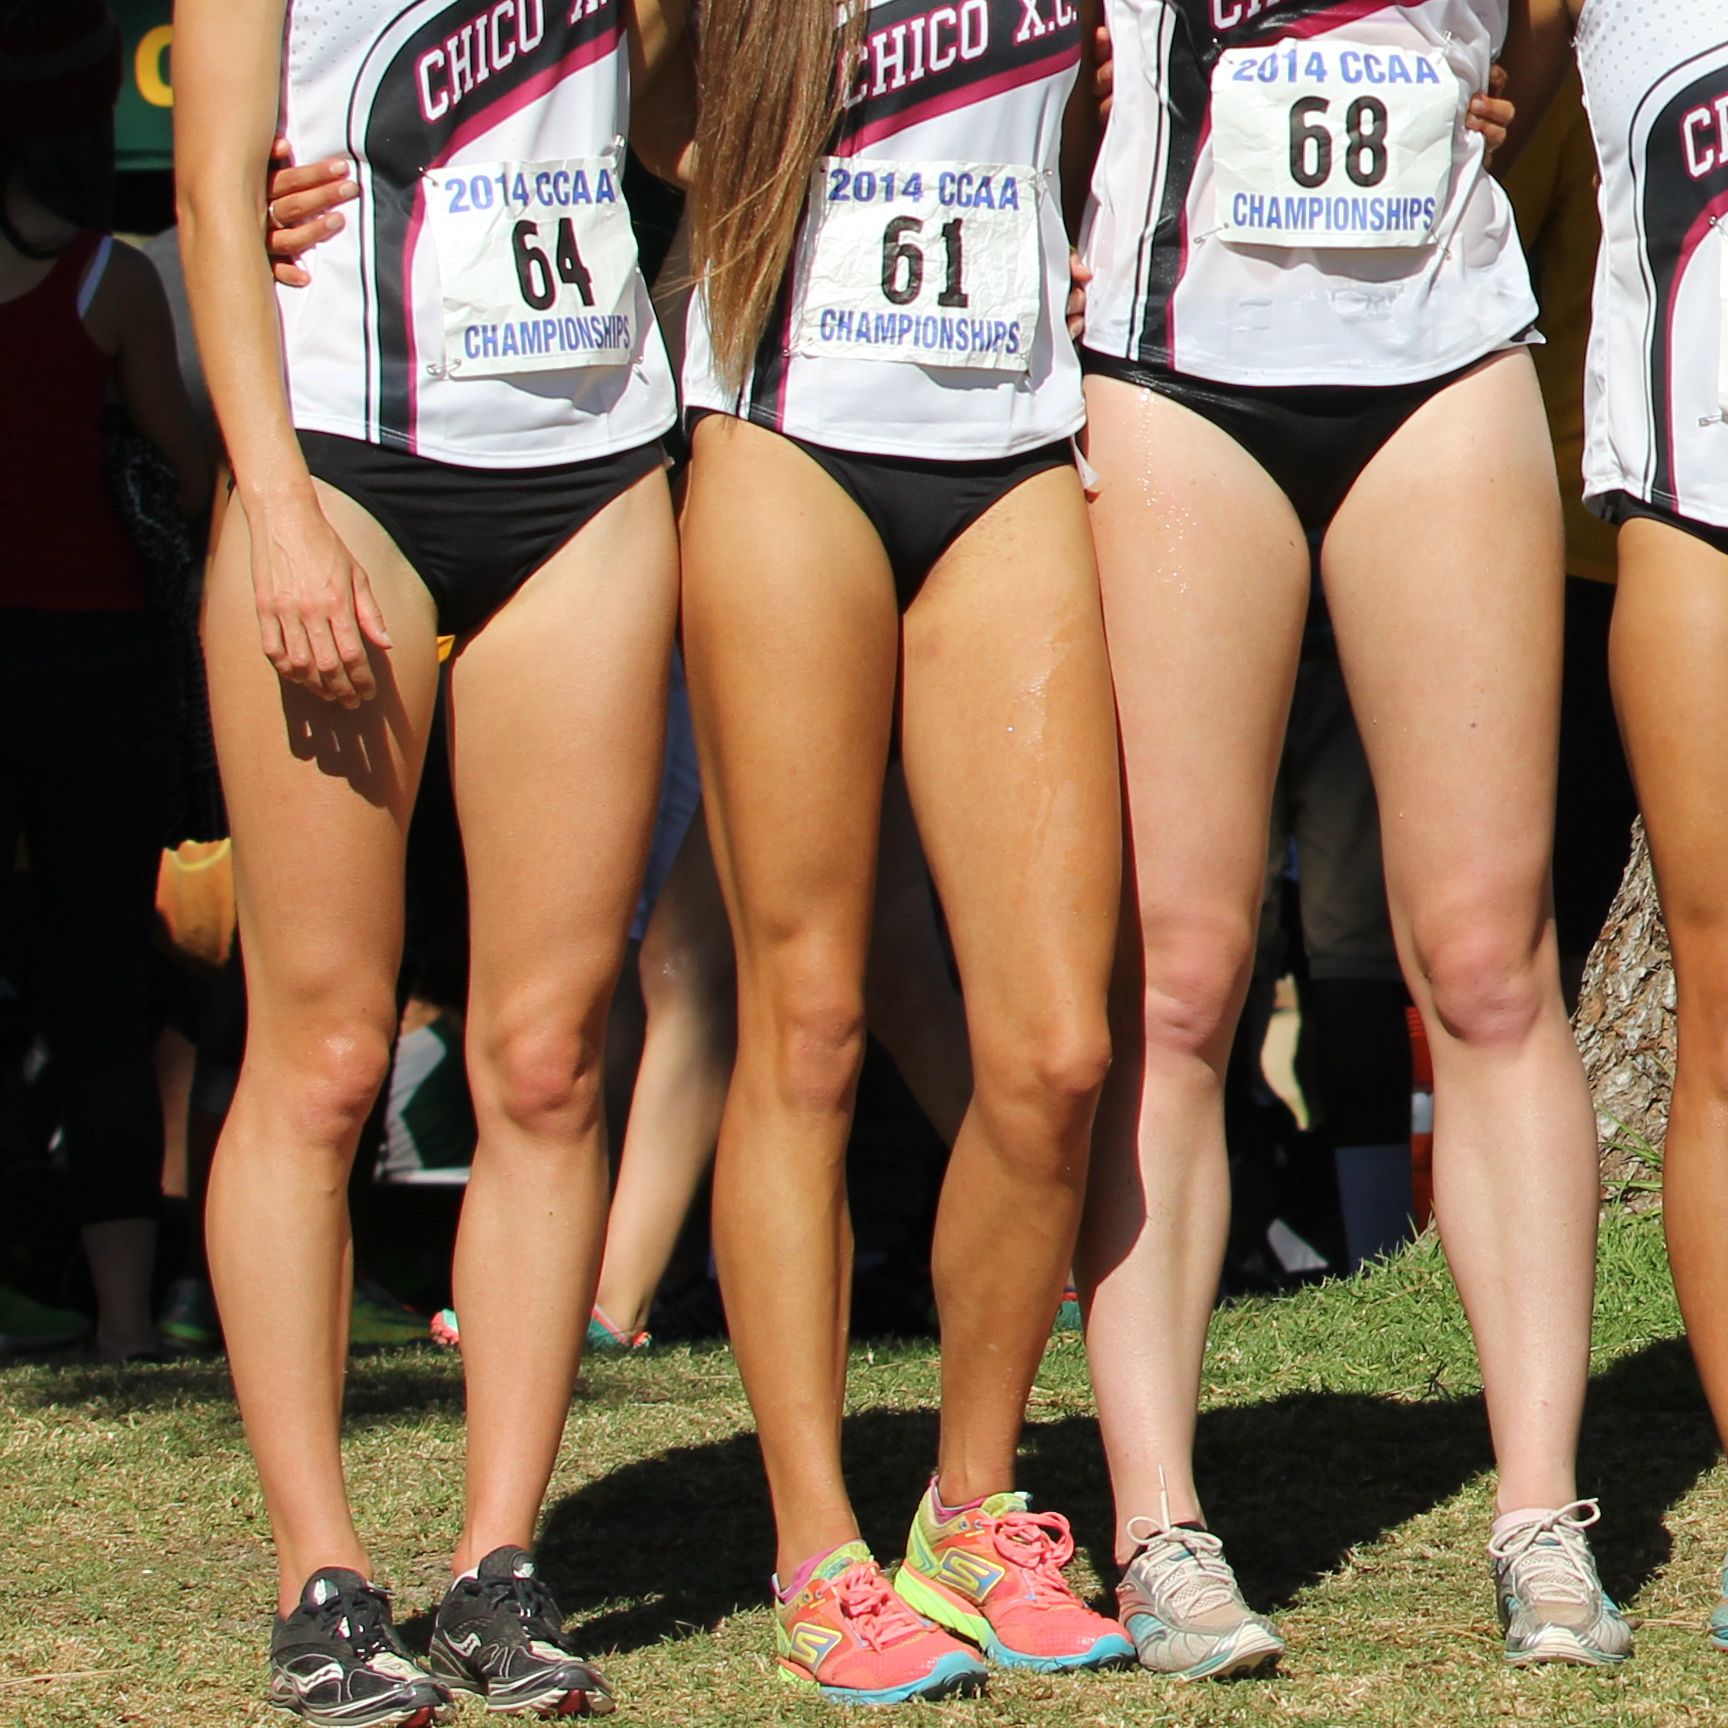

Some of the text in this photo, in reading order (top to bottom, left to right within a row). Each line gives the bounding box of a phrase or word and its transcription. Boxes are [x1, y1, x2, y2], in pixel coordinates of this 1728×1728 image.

[1233, 50, 1440, 84] 2014 CCAA
[1289, 95, 1388, 188] 68
[445, 169, 616, 214] 2014 CCAA
[829, 169, 1020, 210] 2014 CCAA
[1233, 193, 1436, 231] CHAMPIONSHIPS
[511, 217, 595, 311] 64
[882, 216, 968, 308] 61
[464, 314, 631, 358] CHAMPIONSHIPS
[821, 309, 1020, 354] CHAMPIONSHIPS
